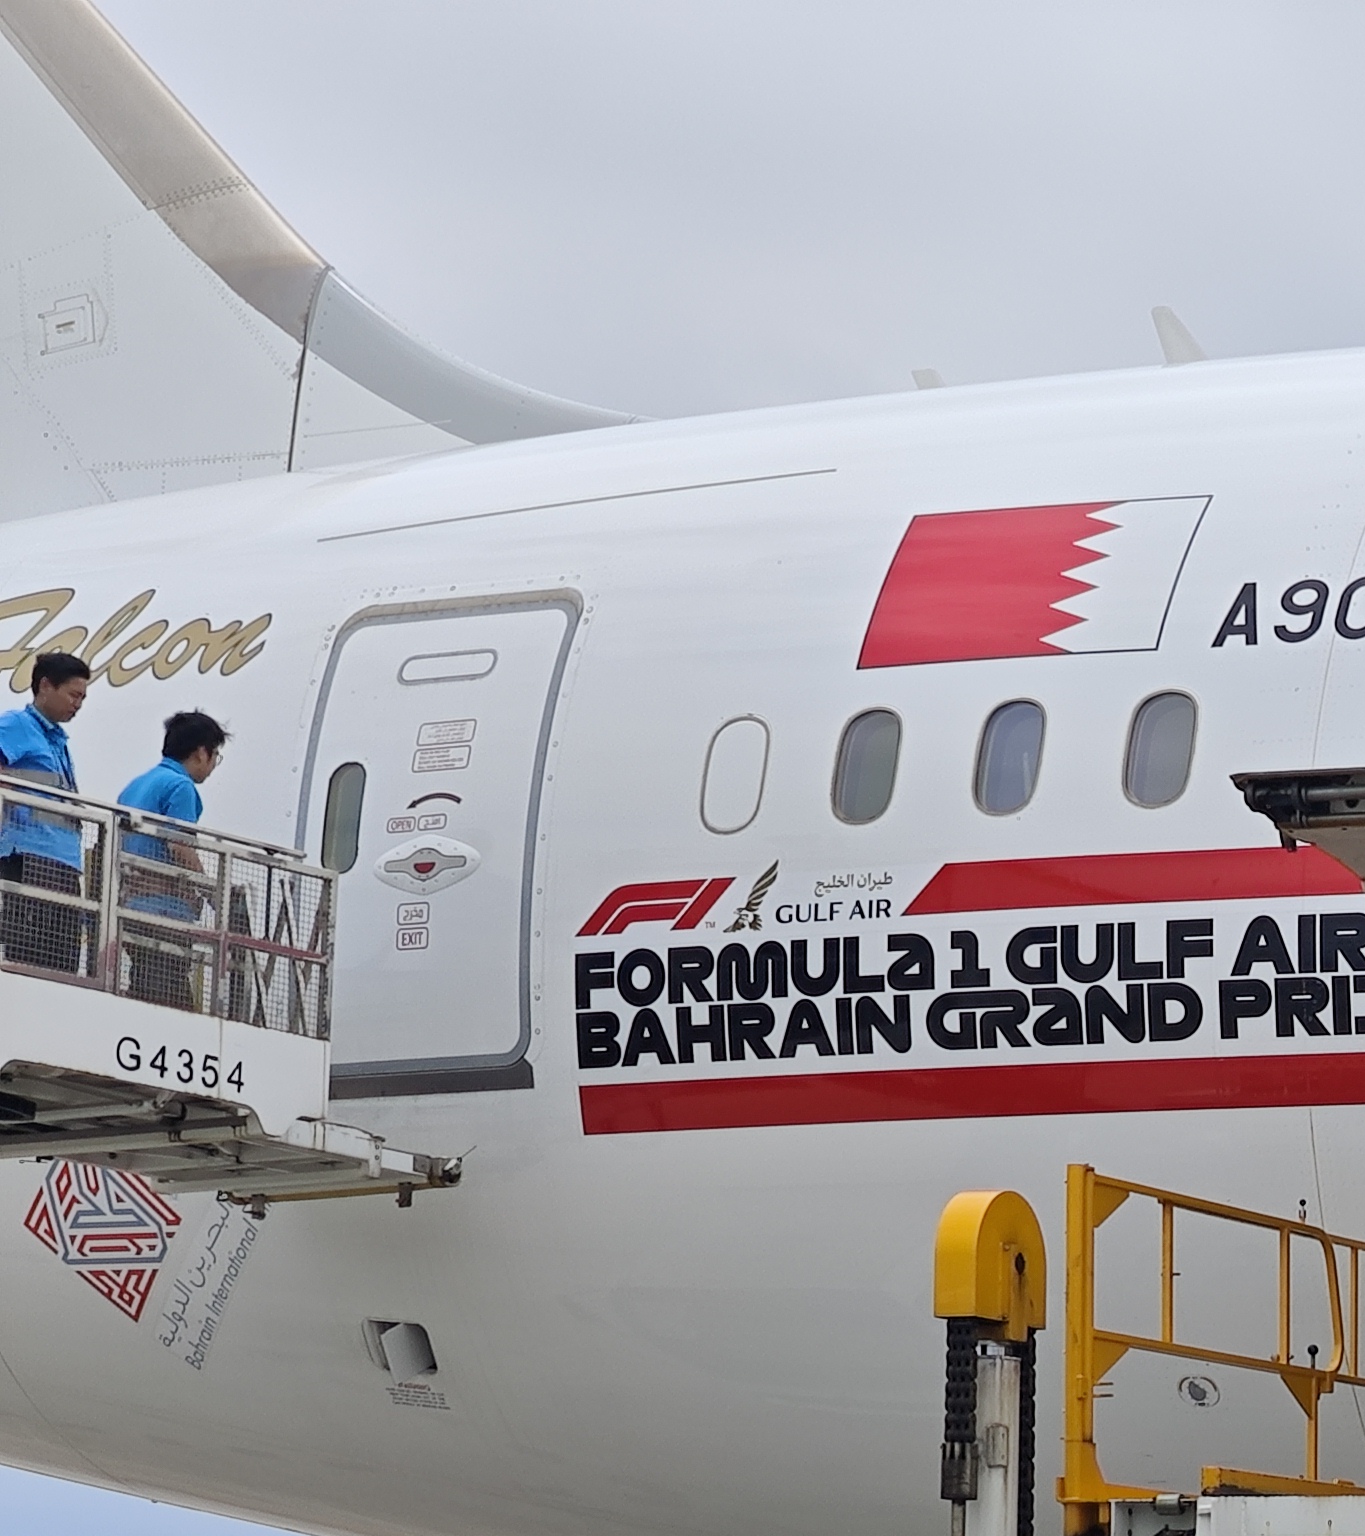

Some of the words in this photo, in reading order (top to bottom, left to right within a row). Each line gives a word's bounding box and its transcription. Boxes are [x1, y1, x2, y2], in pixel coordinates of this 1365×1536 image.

[390, 820, 412, 831] OPEN
[814, 873, 855, 897] الخليج
[857, 872, 893, 891] طيران
[775, 902, 843, 924] GULF
[849, 899, 892, 921] AIR
[401, 931, 423, 947] EXIT
[950, 930, 991, 988] 1
[1005, 917, 1215, 984] GULF
[575, 994, 912, 1070] BAHRAIN
[116, 1036, 245, 1093] G4354
[184, 1316, 218, 1371] Bahrain
[204, 1216, 260, 1317] International
